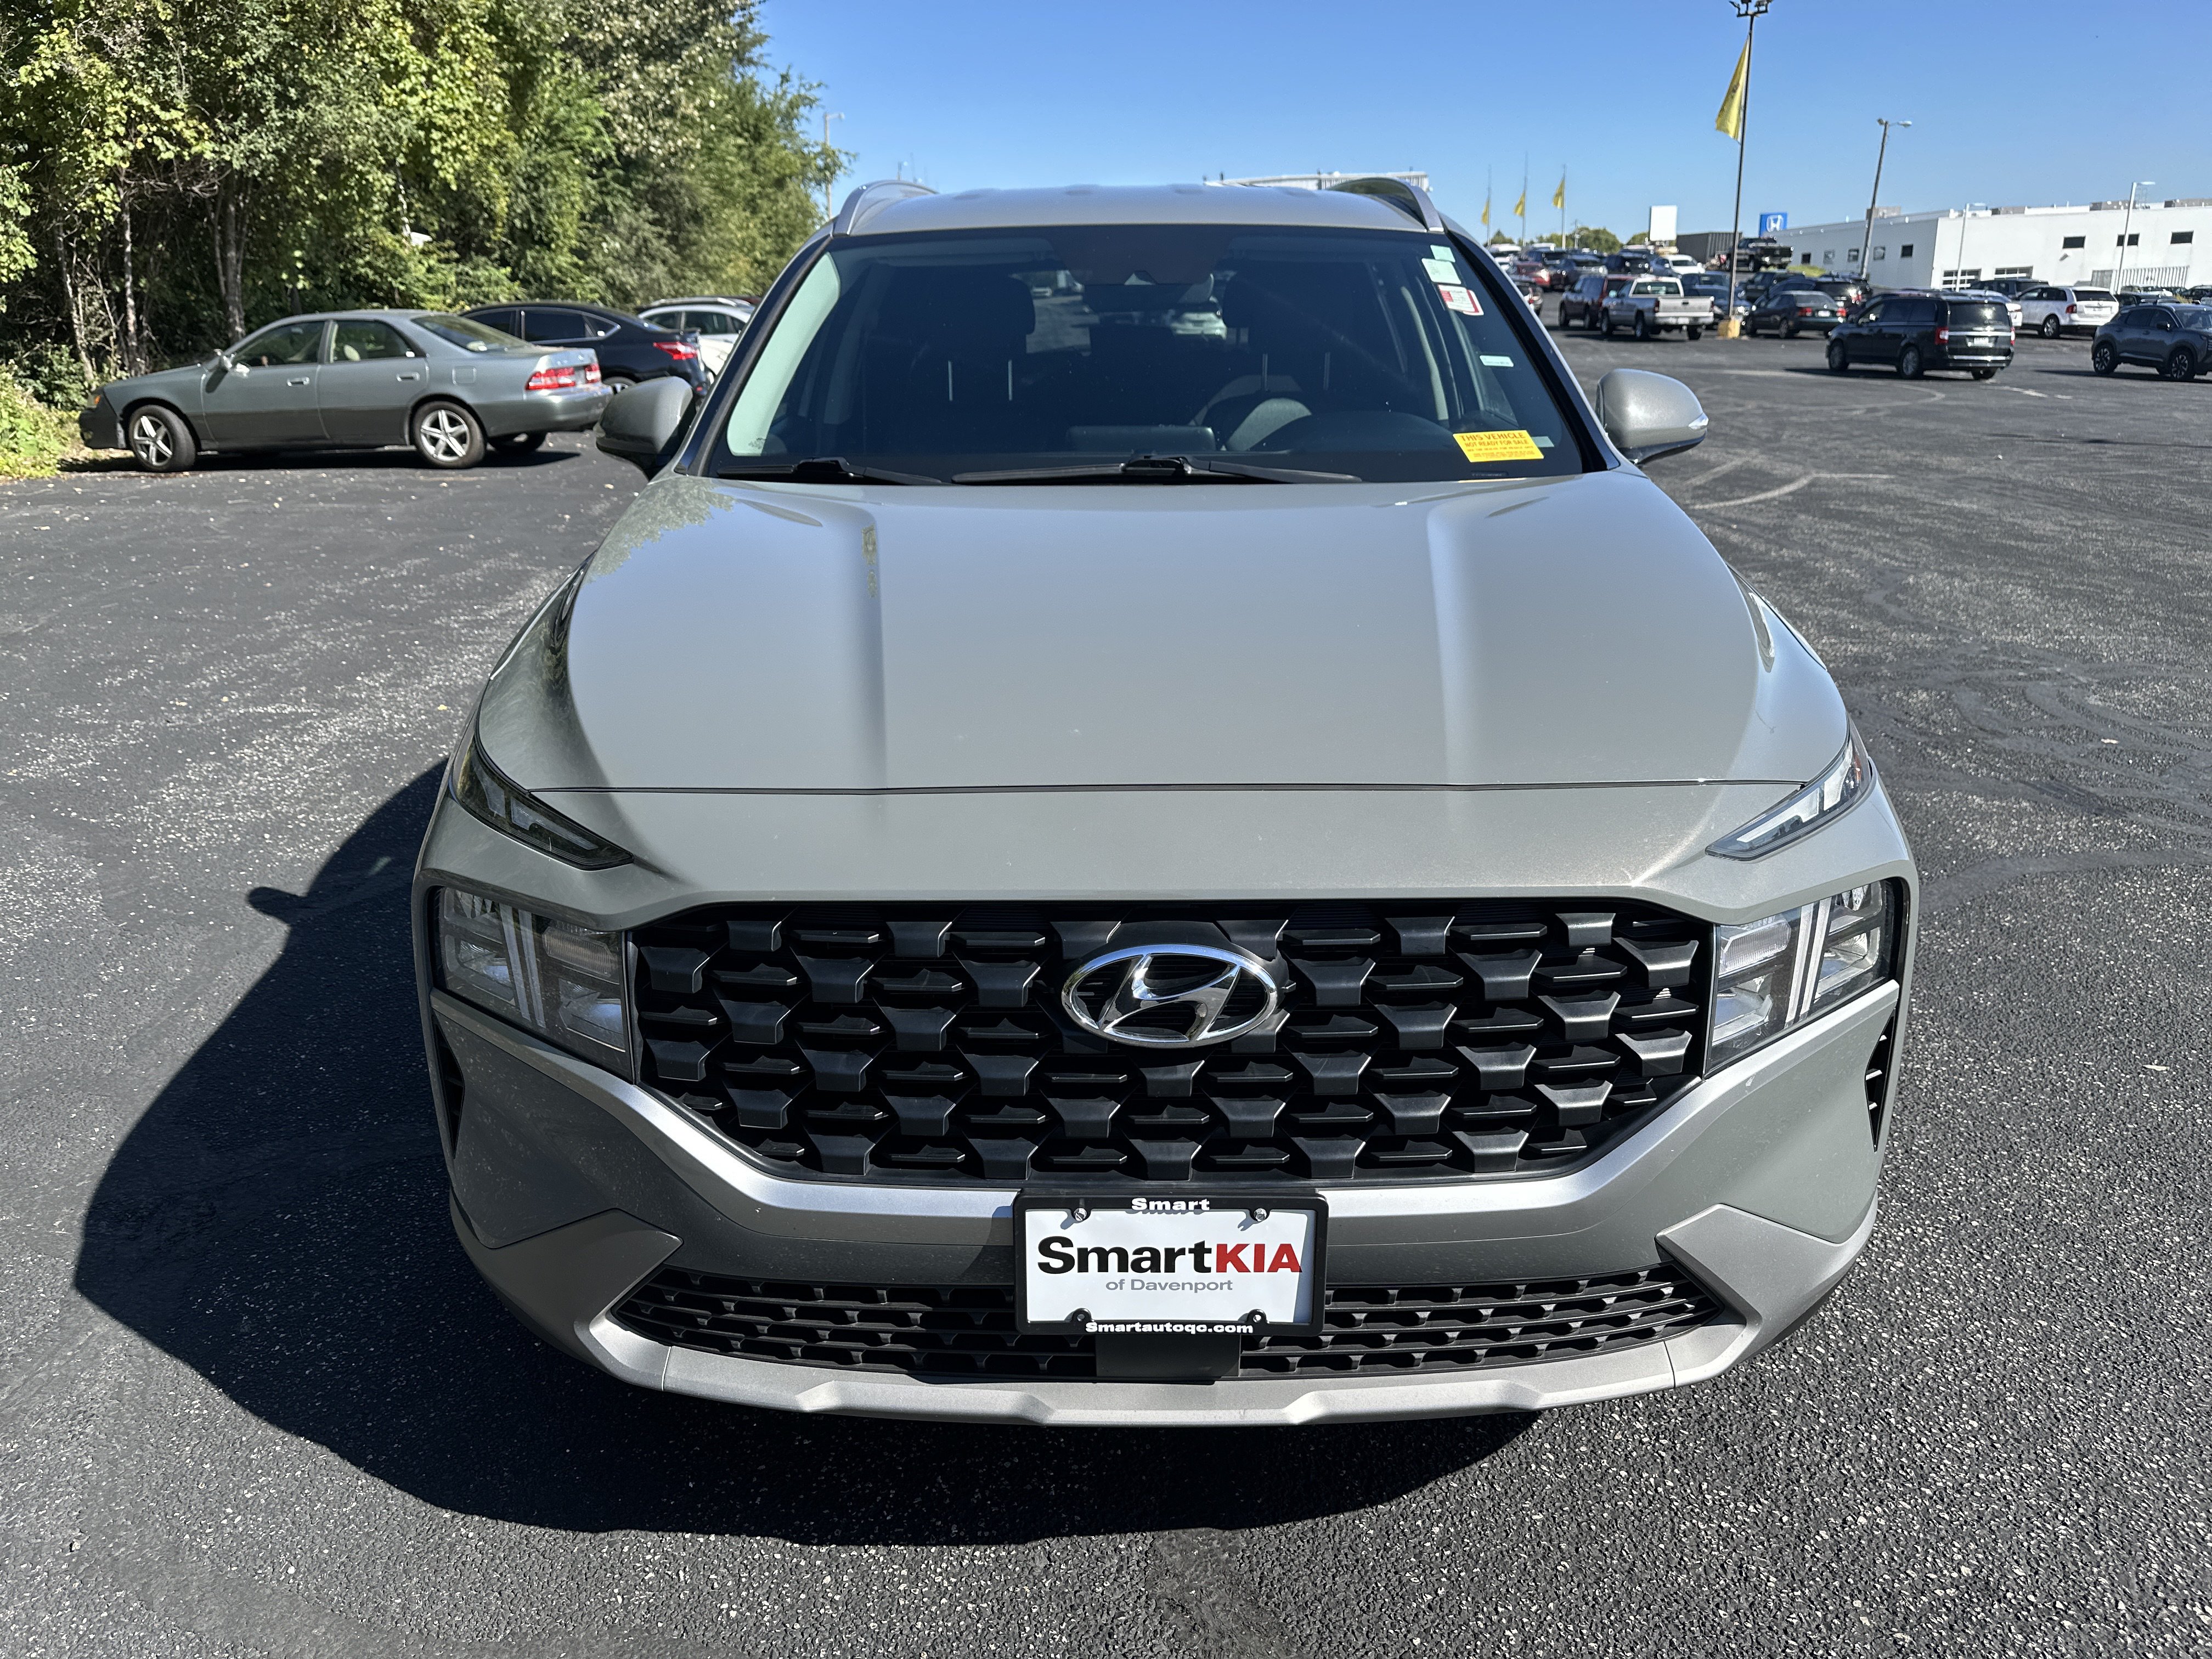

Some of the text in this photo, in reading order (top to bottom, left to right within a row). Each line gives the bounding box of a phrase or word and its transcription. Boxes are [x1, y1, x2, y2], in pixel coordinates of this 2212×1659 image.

[1131, 1198, 1210, 1211] Smart
[1105, 1279, 1233, 1293] of Davenport
[1085, 1322, 1254, 1334] Smartautoqc.com
